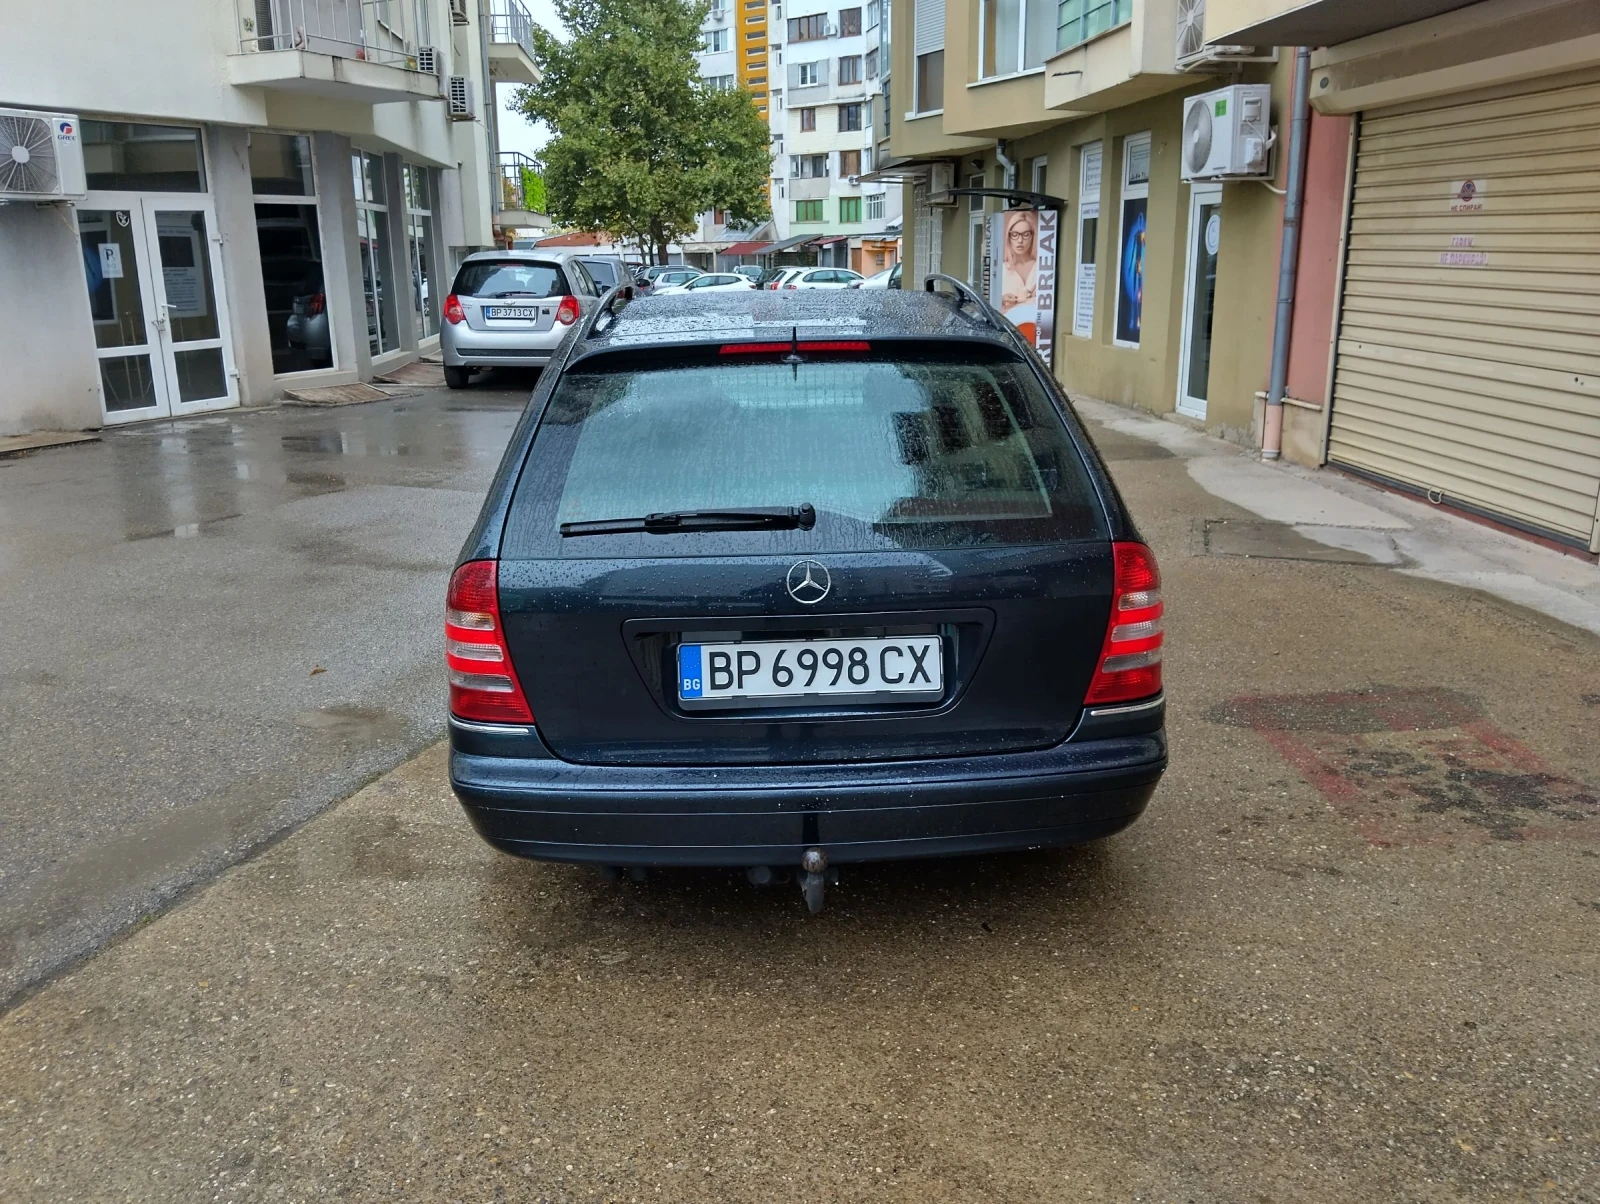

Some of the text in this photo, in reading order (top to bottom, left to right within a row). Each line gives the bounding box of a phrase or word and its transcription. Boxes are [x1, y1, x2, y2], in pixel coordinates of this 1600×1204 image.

[1038, 211, 1056, 311] BREAK
[491, 308, 534, 316] BP 3713 CX
[709, 644, 932, 691] BP 6998 CX
[683, 678, 701, 691] BG
